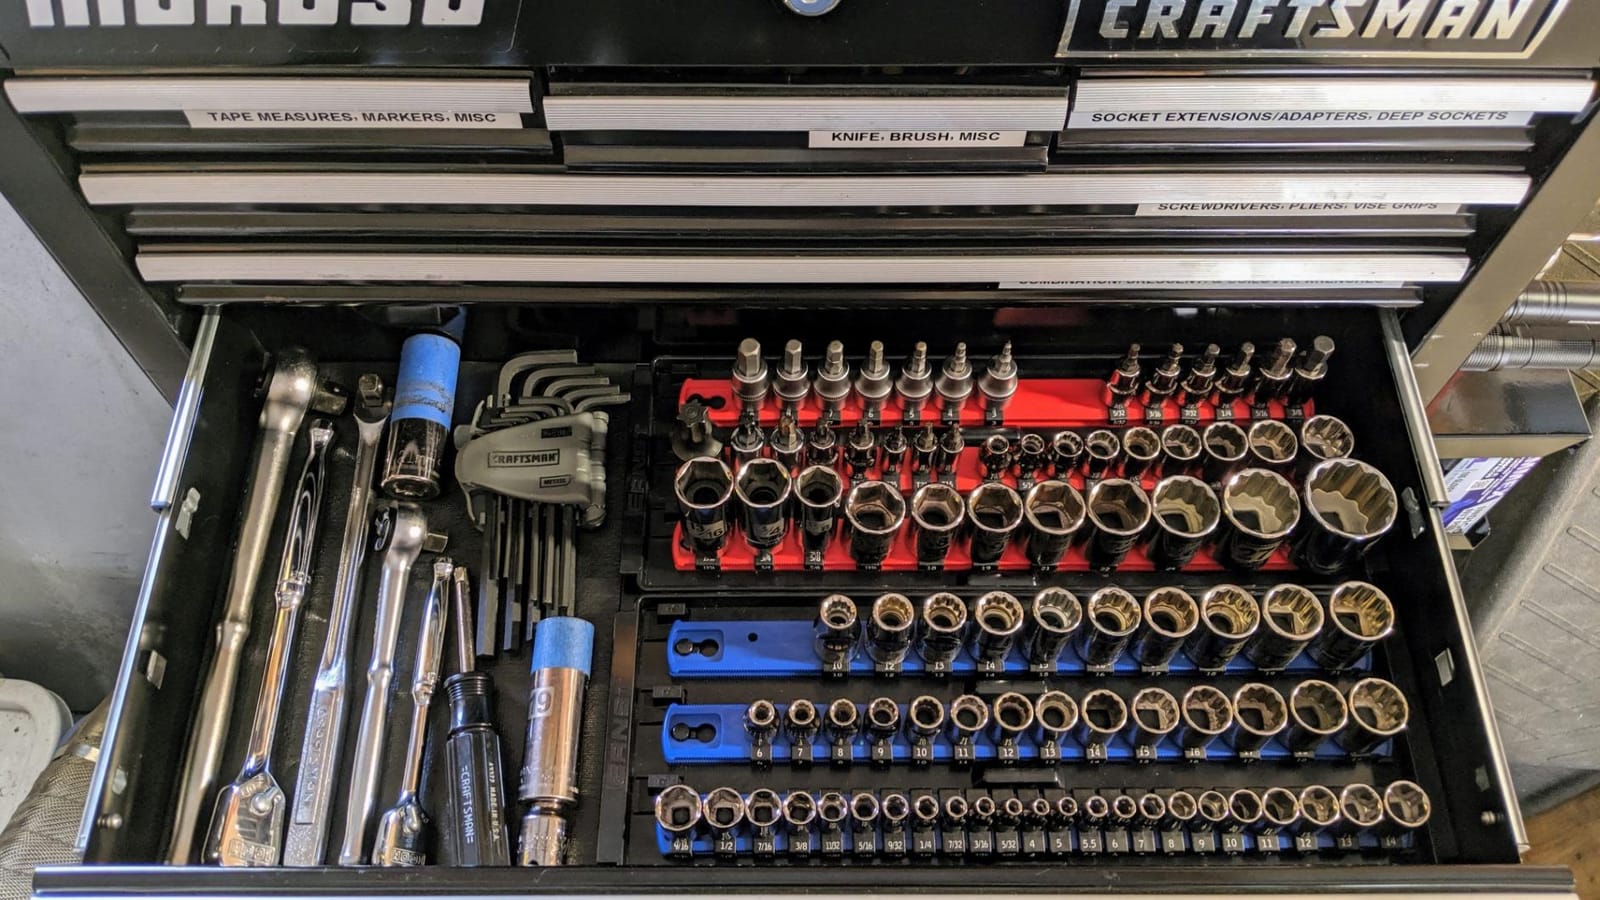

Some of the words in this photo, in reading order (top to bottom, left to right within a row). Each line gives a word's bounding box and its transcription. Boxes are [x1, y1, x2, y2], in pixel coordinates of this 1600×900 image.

[1099, 0, 1530, 39] CRAFTSMAN
[208, 112, 254, 122] TAPE
[455, 112, 497, 123] MISC
[1092, 112, 1161, 122] SOCKET
[1377, 111, 1424, 121] DEEP
[1427, 111, 1508, 121] SOCKETS
[959, 132, 1001, 141] MISC
[493, 453, 557, 465] CRAFTSMAN
[756, 748, 763, 758] 6
[797, 748, 804, 758] 7
[837, 748, 844, 758] 8
[877, 748, 884, 758] 9
[916, 748, 928, 758] 10
[957, 748, 969, 758] 11
[1002, 748, 1014, 758] 12
[720, 841, 733, 851] 1/2
[757, 841, 772, 851] 7/16
[795, 840, 808, 851] 3/8
[825, 840, 840, 851] 11/32
[858, 840, 873, 851] 5/16
[888, 840, 903, 851] 9/32
[919, 840, 932, 849] 1/4
[949, 839, 963, 850] 7/32
[1029, 839, 1035, 849] 4
[1056, 839, 1062, 849] 5
[1082, 839, 1097, 849] 5.5
[1111, 839, 1118, 849] 6
[1138, 839, 1144, 849] 7
[1168, 839, 1175, 849] 8
[1198, 839, 1205, 849] 9
[1225, 838, 1237, 848] 10
[1261, 838, 1273, 848] 11
[1300, 838, 1312, 848] 12
